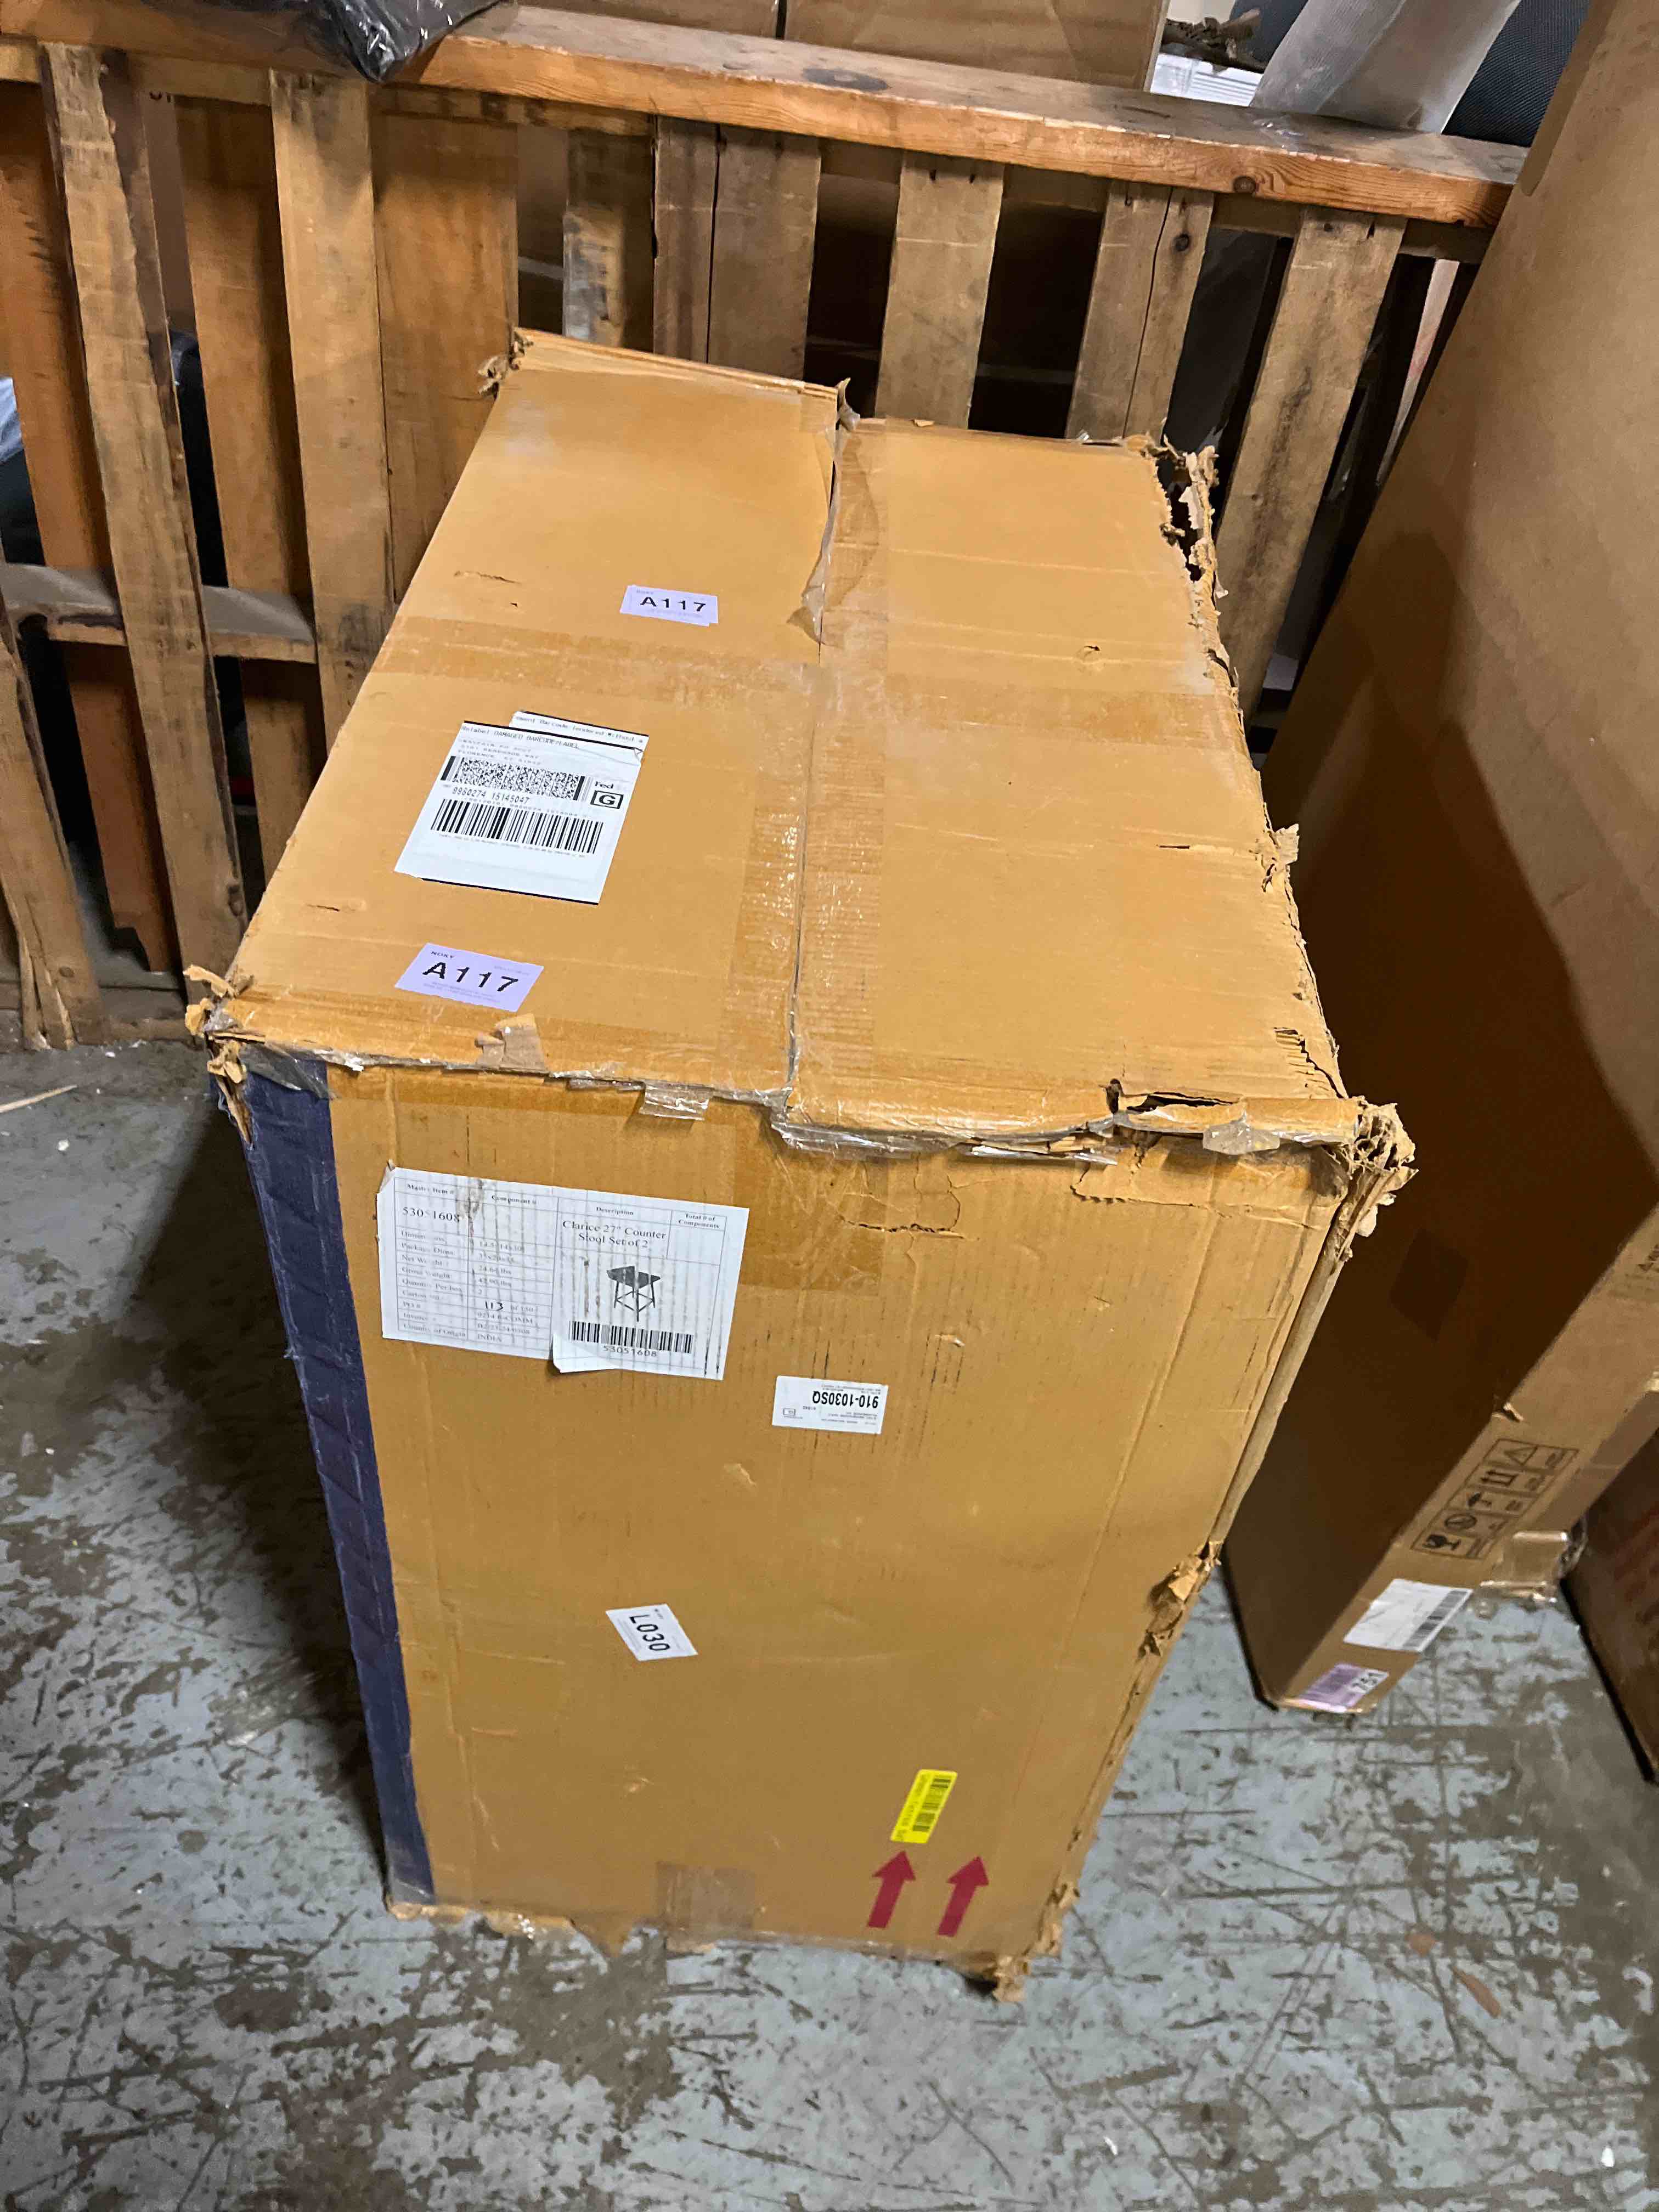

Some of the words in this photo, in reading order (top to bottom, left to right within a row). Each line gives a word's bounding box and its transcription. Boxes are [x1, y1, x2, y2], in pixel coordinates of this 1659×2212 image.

[640, 597, 706, 612] A117
[452, 786, 486, 798] 9980274
[492, 793, 530, 804] 15145047
[599, 794, 616, 805] G
[422, 962, 518, 992] A117
[596, 1206, 634, 1216] Description
[678, 1219, 720, 1229] Components
[624, 1227, 667, 1239] Counter
[627, 1238, 640, 1247] of
[485, 1301, 504, 1312] 113
[603, 1345, 657, 1357] 53051608
[812, 1391, 878, 1408] 910-1030SQ
[629, 1615, 670, 1651] L030
